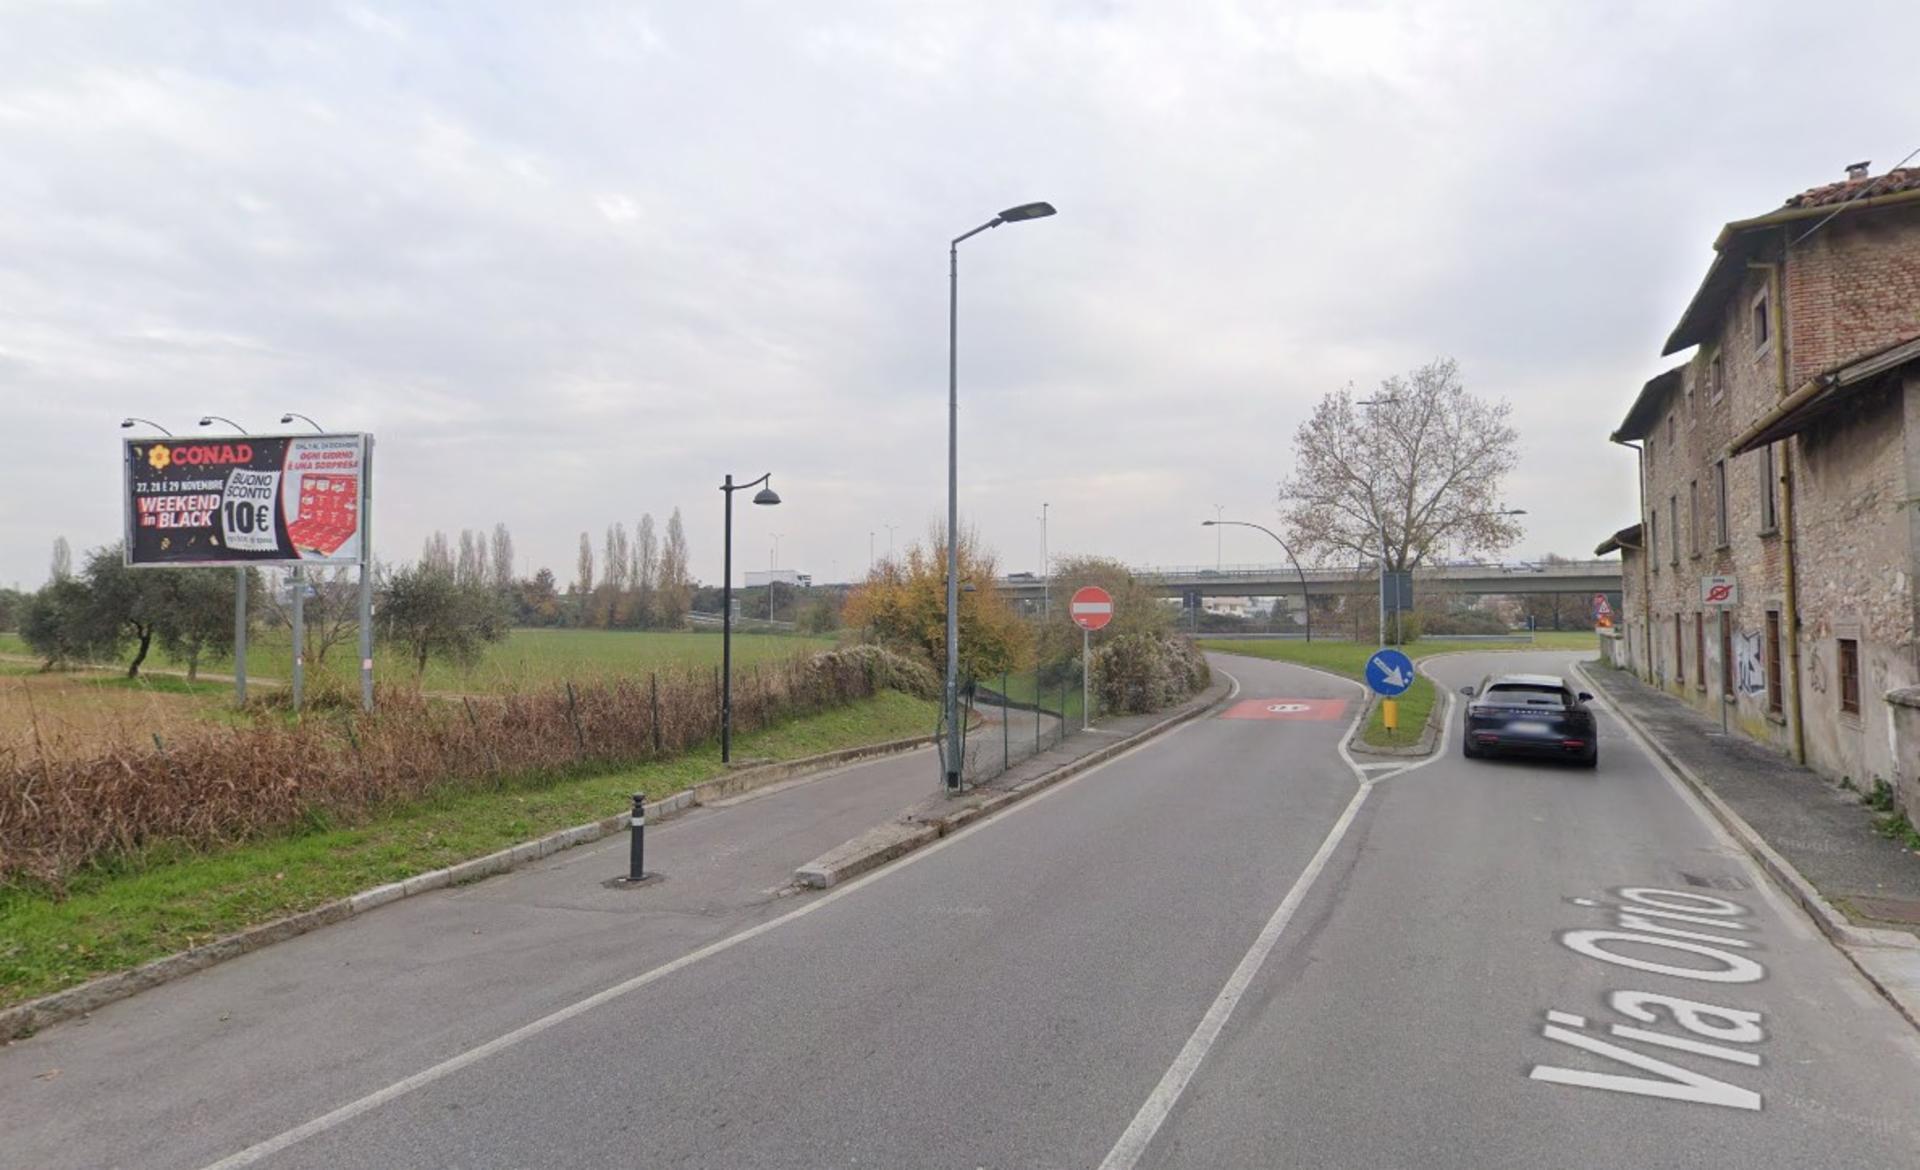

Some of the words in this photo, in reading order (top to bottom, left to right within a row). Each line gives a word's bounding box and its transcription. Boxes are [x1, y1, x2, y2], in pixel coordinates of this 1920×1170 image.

[172, 445, 253, 465] CONAD
[300, 452, 320, 460] OGNI
[321, 450, 354, 459] GIORNO
[295, 462, 313, 470] UNA
[315, 460, 358, 470] SORPRESA
[151, 482, 161, 492] 28
[169, 481, 180, 492] 29
[180, 479, 224, 491] NOVEMBRE
[232, 473, 273, 486] BUONO
[227, 487, 272, 499] SCONTO
[139, 494, 221, 512] WEEKEND
[142, 513, 156, 526] in
[157, 510, 212, 529] BLACK
